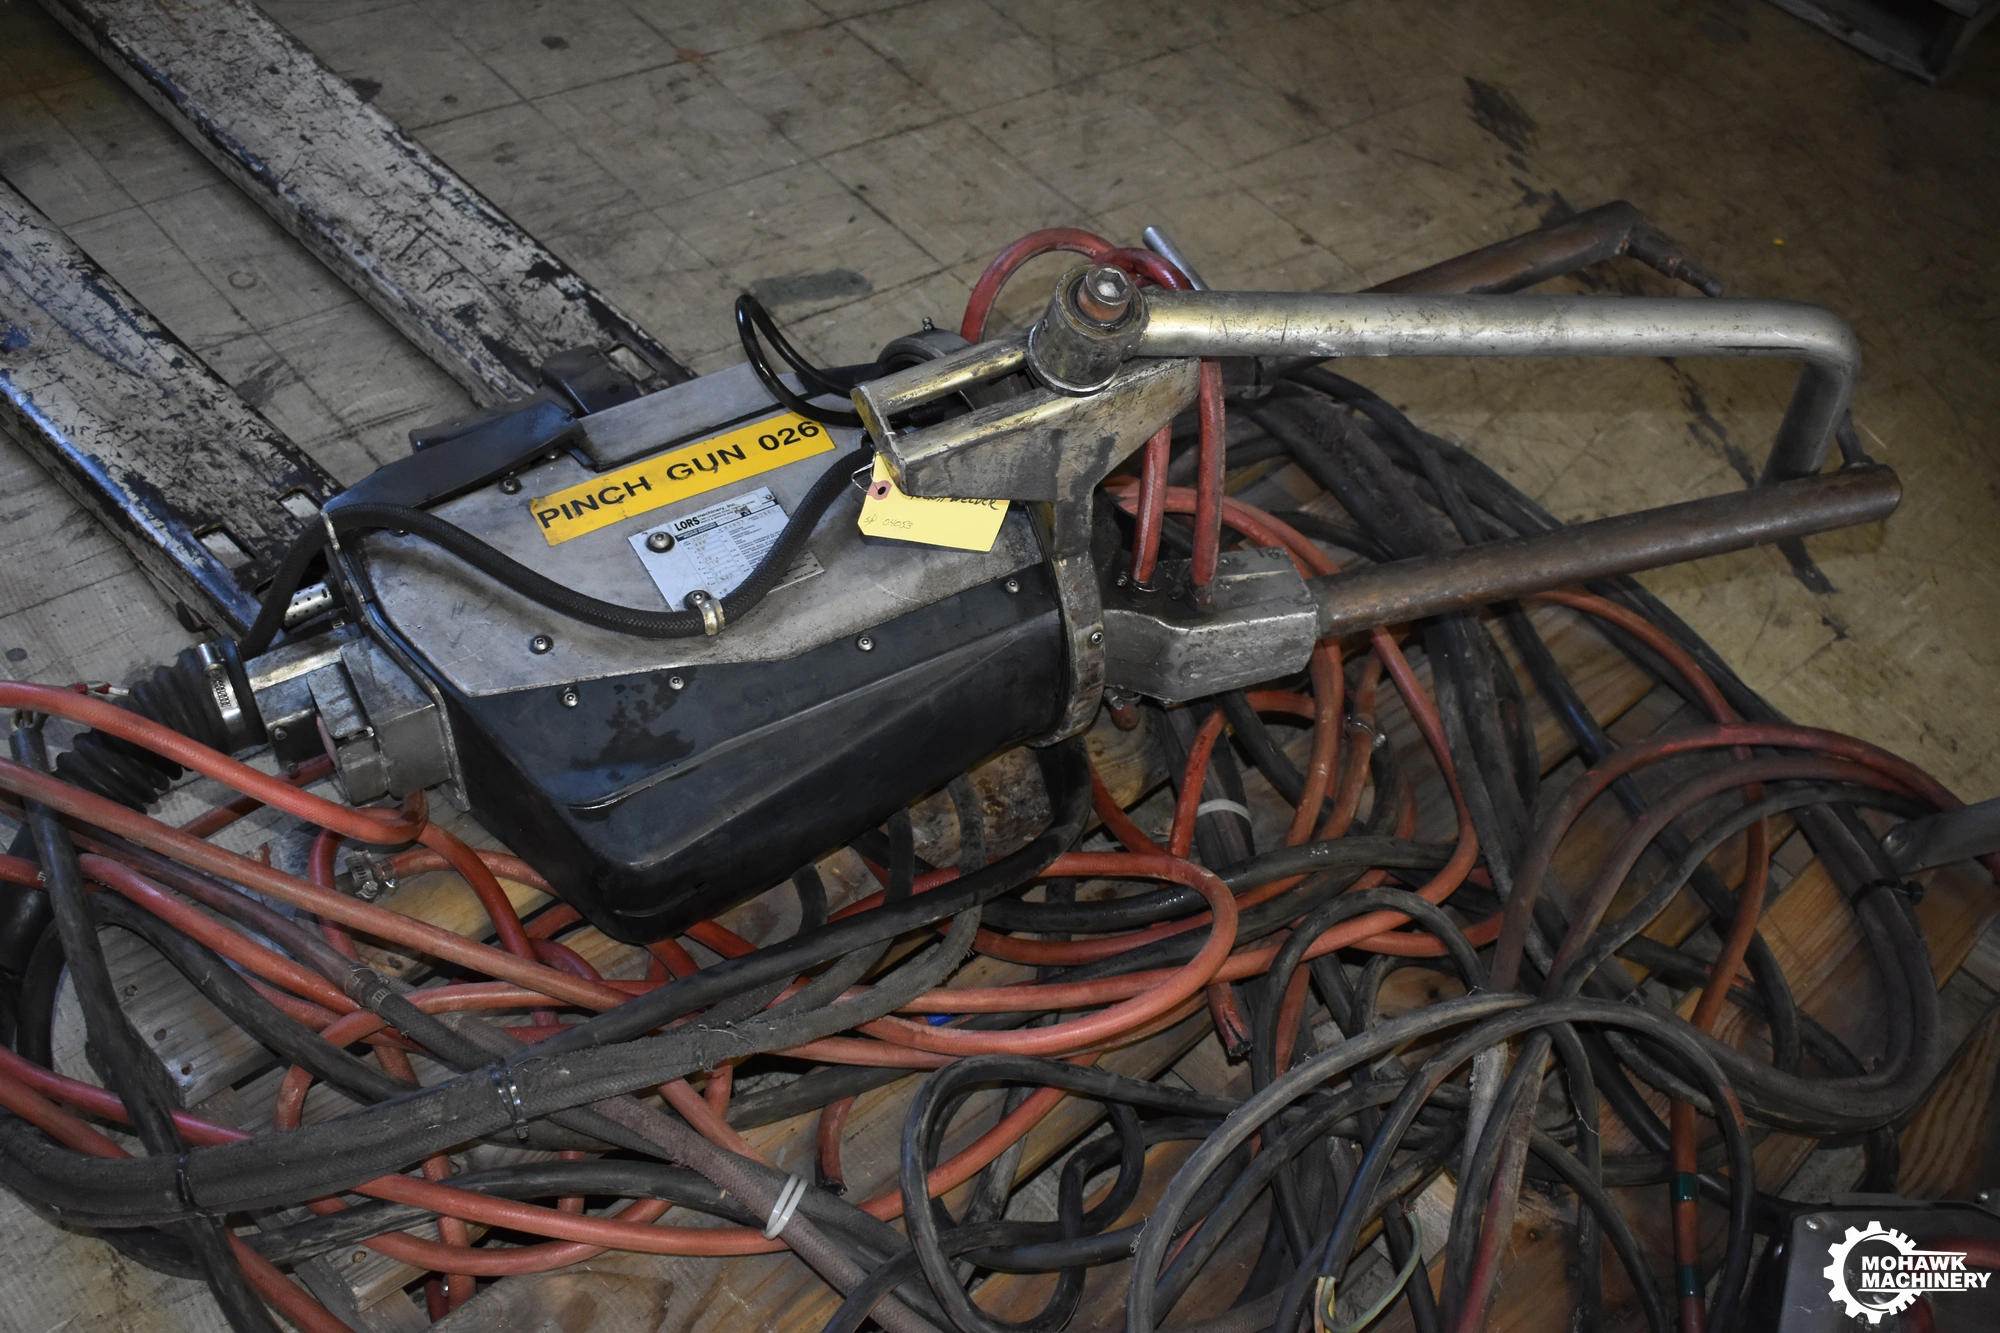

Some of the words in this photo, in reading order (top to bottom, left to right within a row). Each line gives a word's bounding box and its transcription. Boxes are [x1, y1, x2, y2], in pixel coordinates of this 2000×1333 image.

[536, 475, 652, 529] PINCH
[666, 443, 747, 481] GUN
[758, 420, 820, 451] 026
[674, 516, 700, 532] LORS
